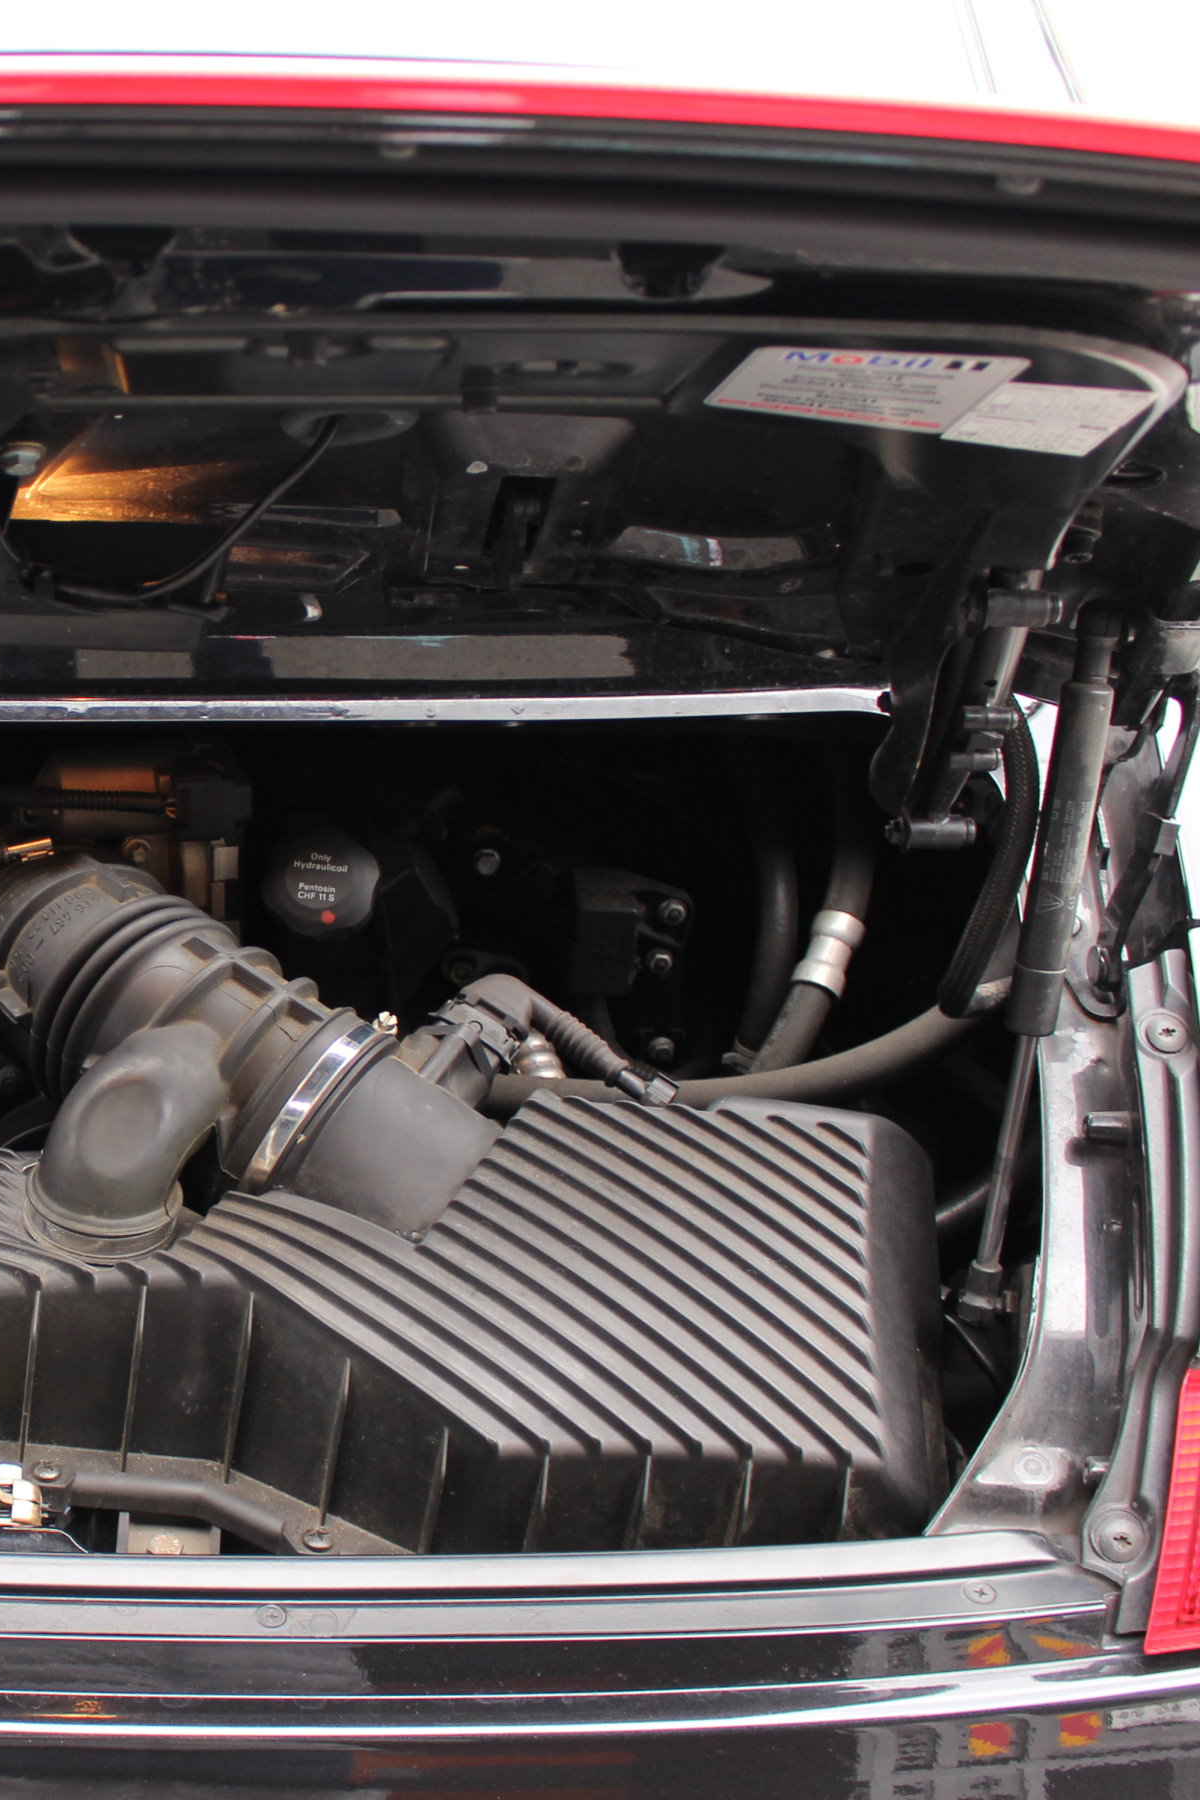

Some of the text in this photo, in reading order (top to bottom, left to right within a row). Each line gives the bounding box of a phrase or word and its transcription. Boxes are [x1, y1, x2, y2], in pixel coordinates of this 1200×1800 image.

[784, 350, 933, 368] Mobil
[310, 852, 332, 862] Only
[293, 860, 348, 873] Hydraulicoil
[298, 881, 336, 894] Pentosin
[297, 890, 335, 902] CHF 11 S
